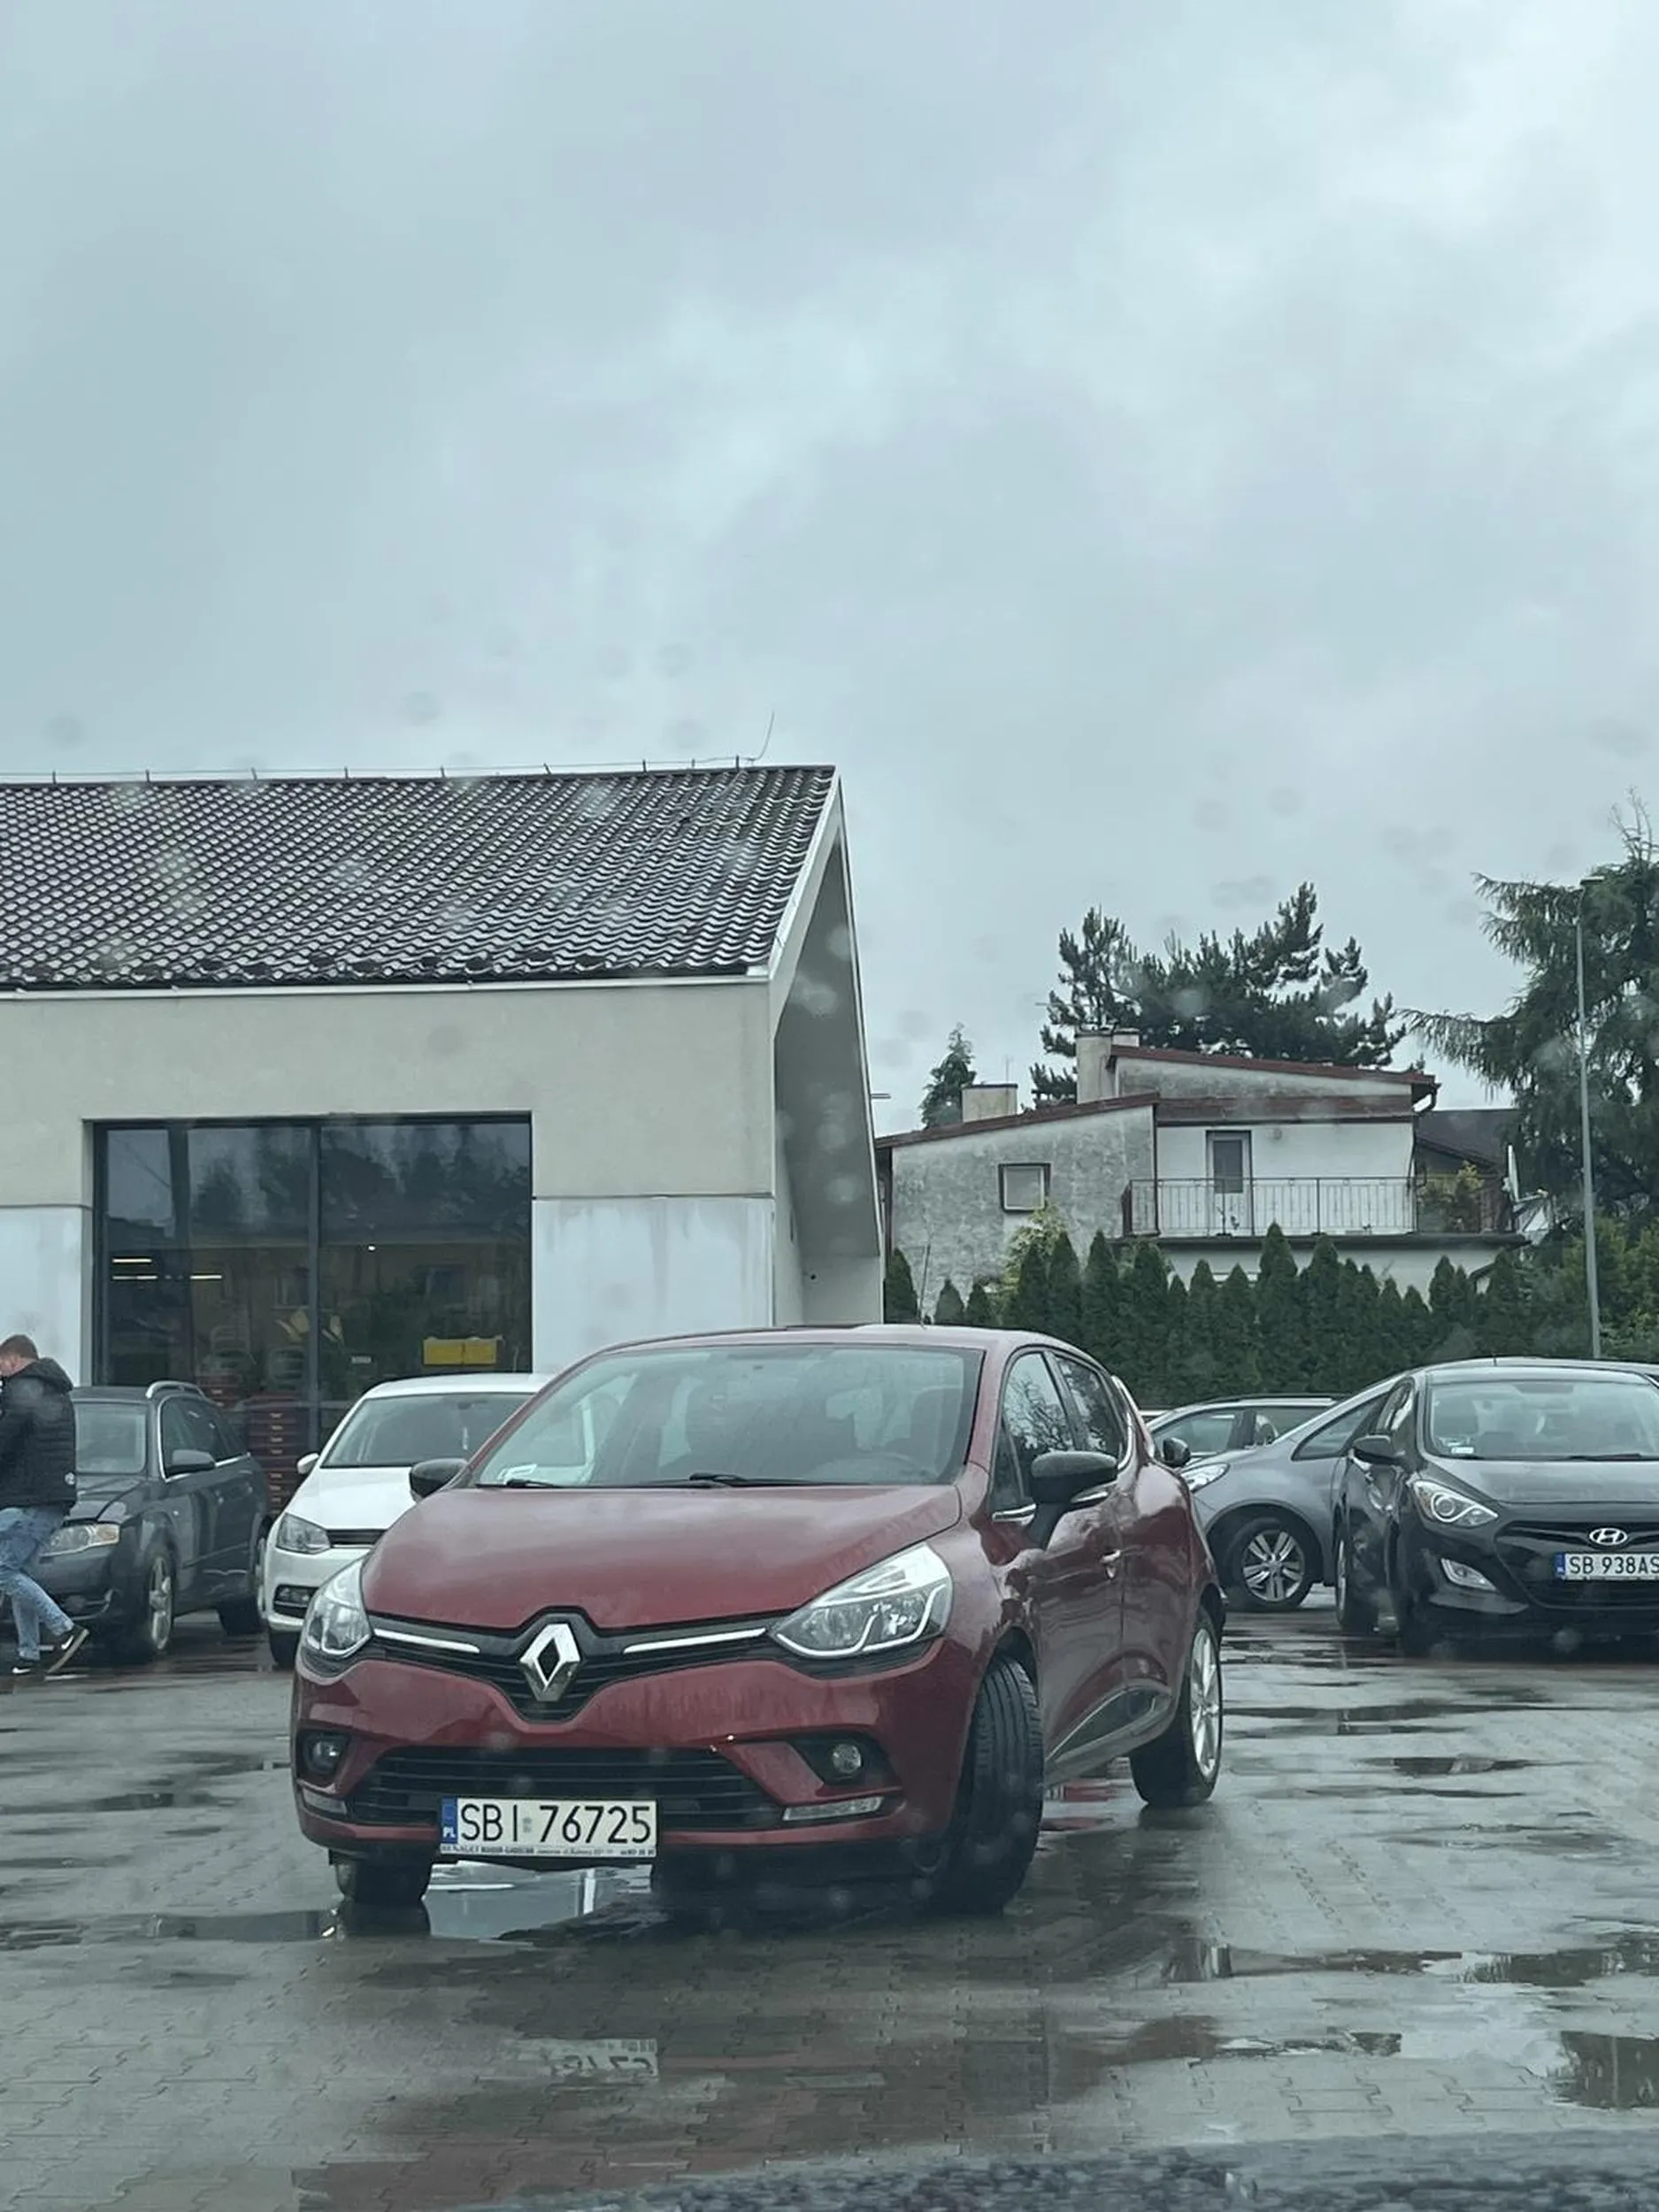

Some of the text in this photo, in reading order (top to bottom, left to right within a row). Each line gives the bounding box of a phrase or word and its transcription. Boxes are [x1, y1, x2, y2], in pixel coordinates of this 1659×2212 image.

[1569, 1555, 1659, 1575] SB 938AS
[460, 1803, 651, 1844] SBI 76725
